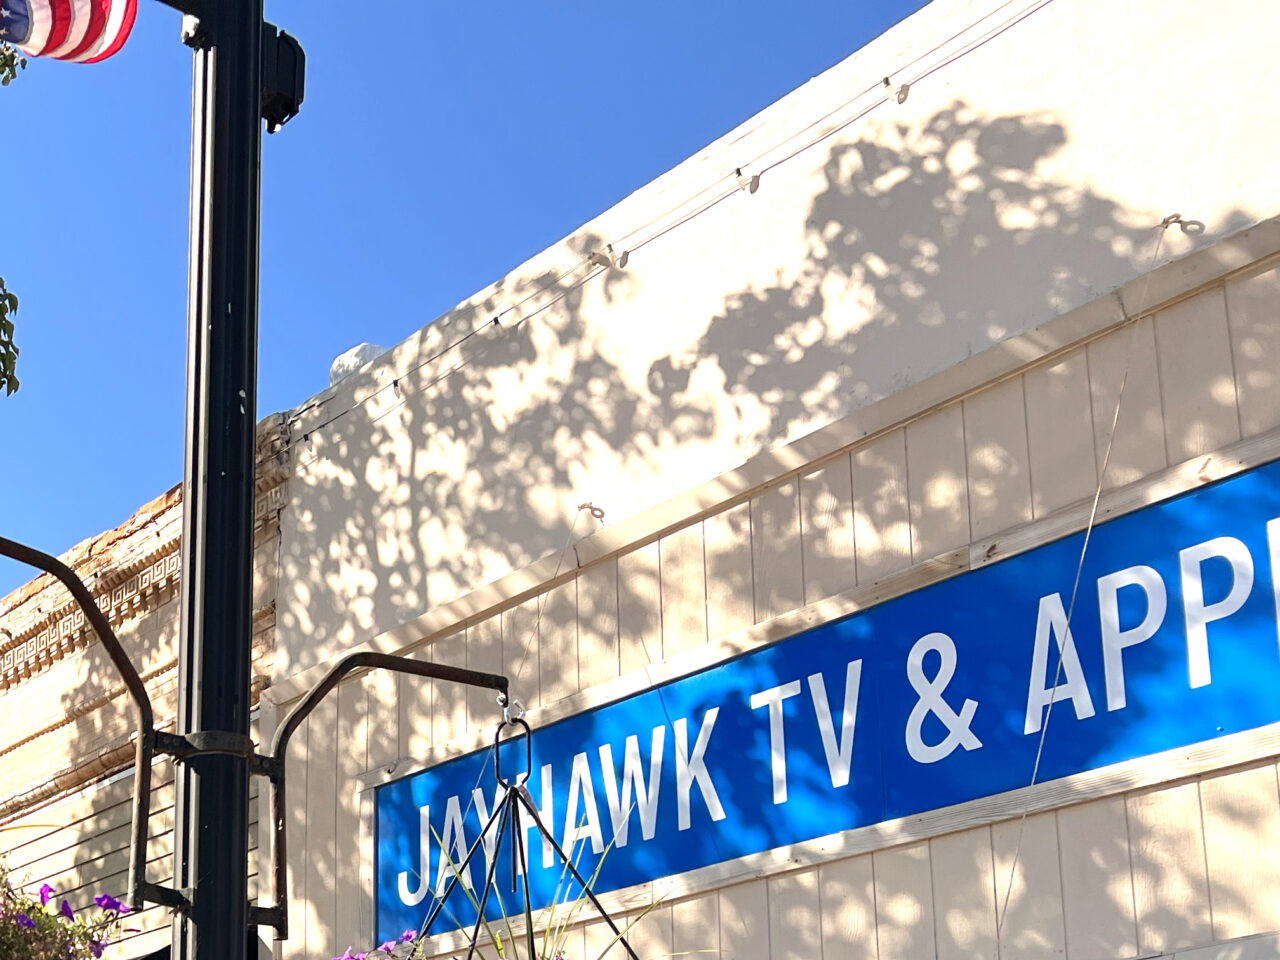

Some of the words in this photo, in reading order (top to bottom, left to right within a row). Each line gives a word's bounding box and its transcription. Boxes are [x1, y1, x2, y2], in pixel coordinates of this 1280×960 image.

[397, 707, 726, 906] JAYHAWK
[751, 658, 862, 805] TV
[904, 631, 983, 764] &
[1023, 517, 1280, 735] APP
